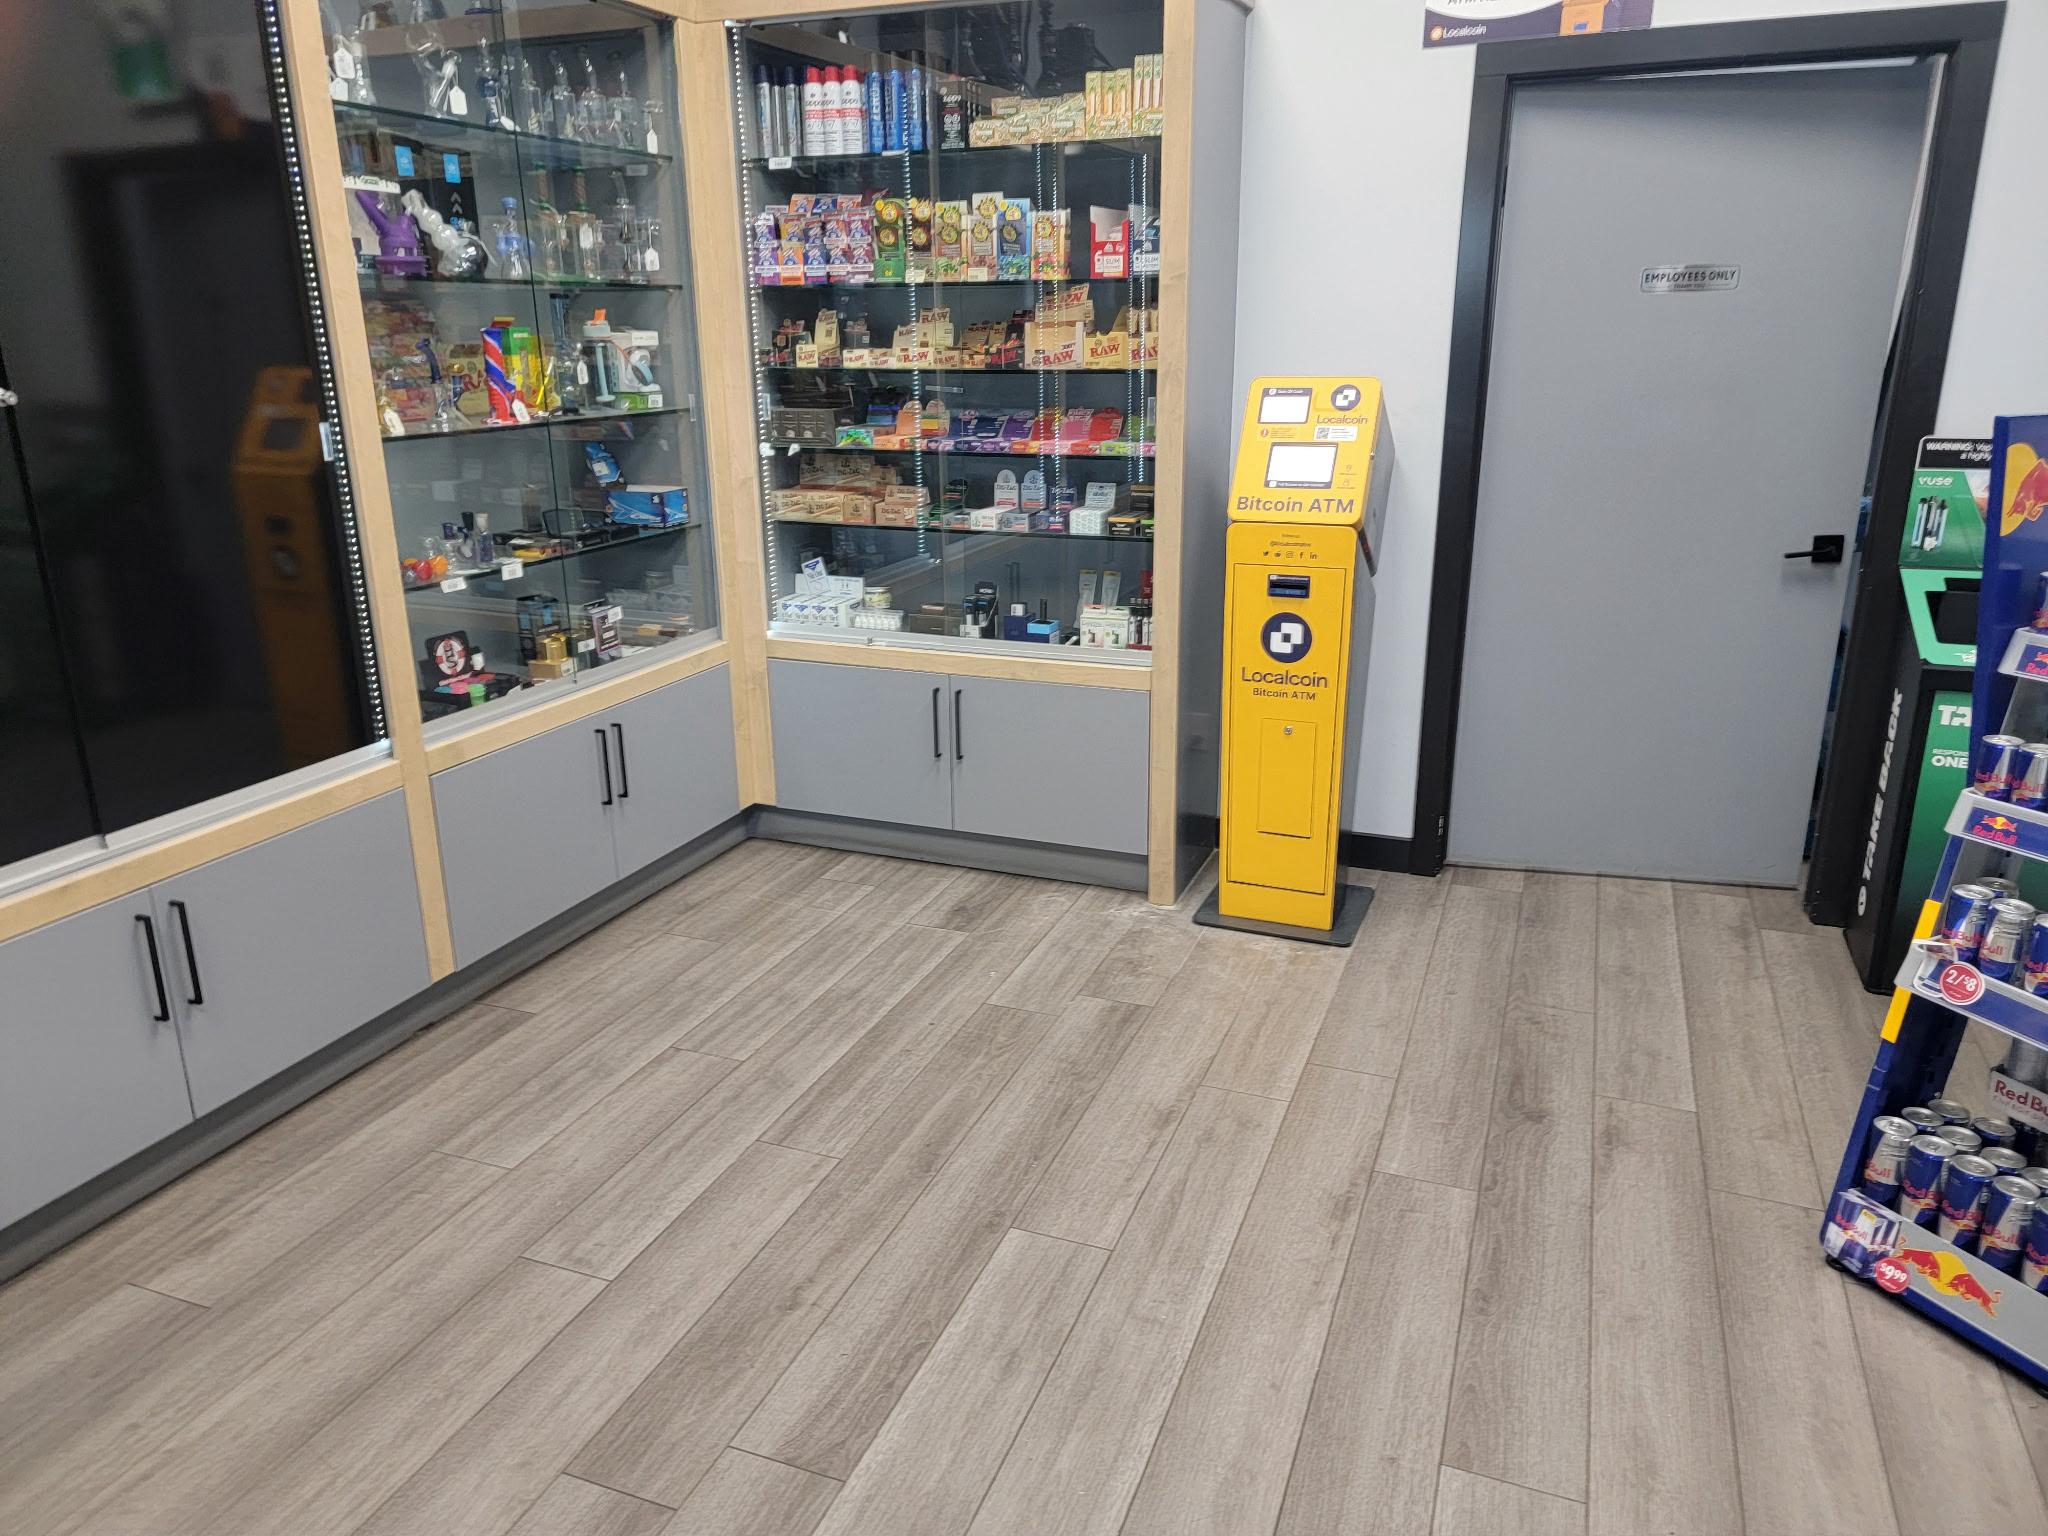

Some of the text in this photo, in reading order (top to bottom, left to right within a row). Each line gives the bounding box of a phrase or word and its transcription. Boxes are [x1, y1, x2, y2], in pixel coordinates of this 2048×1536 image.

[1443, 23, 1487, 39] Localcoin
[1644, 269, 1737, 284] EMPLOYEES ONLY
[1042, 349, 1074, 366] RAW
[1090, 343, 1121, 358] RAW
[1316, 414, 1369, 425] Localcoin
[1236, 496, 1355, 514] Bitcoin ATM
[1241, 666, 1328, 689] Localcoin
[1253, 687, 1316, 701] Bitcoin ATM
[1878, 687, 1903, 793] BACK
[1931, 755, 1970, 769] ONE
[1972, 824, 2017, 846] Red Bull
[1994, 1079, 2030, 1106] Red
